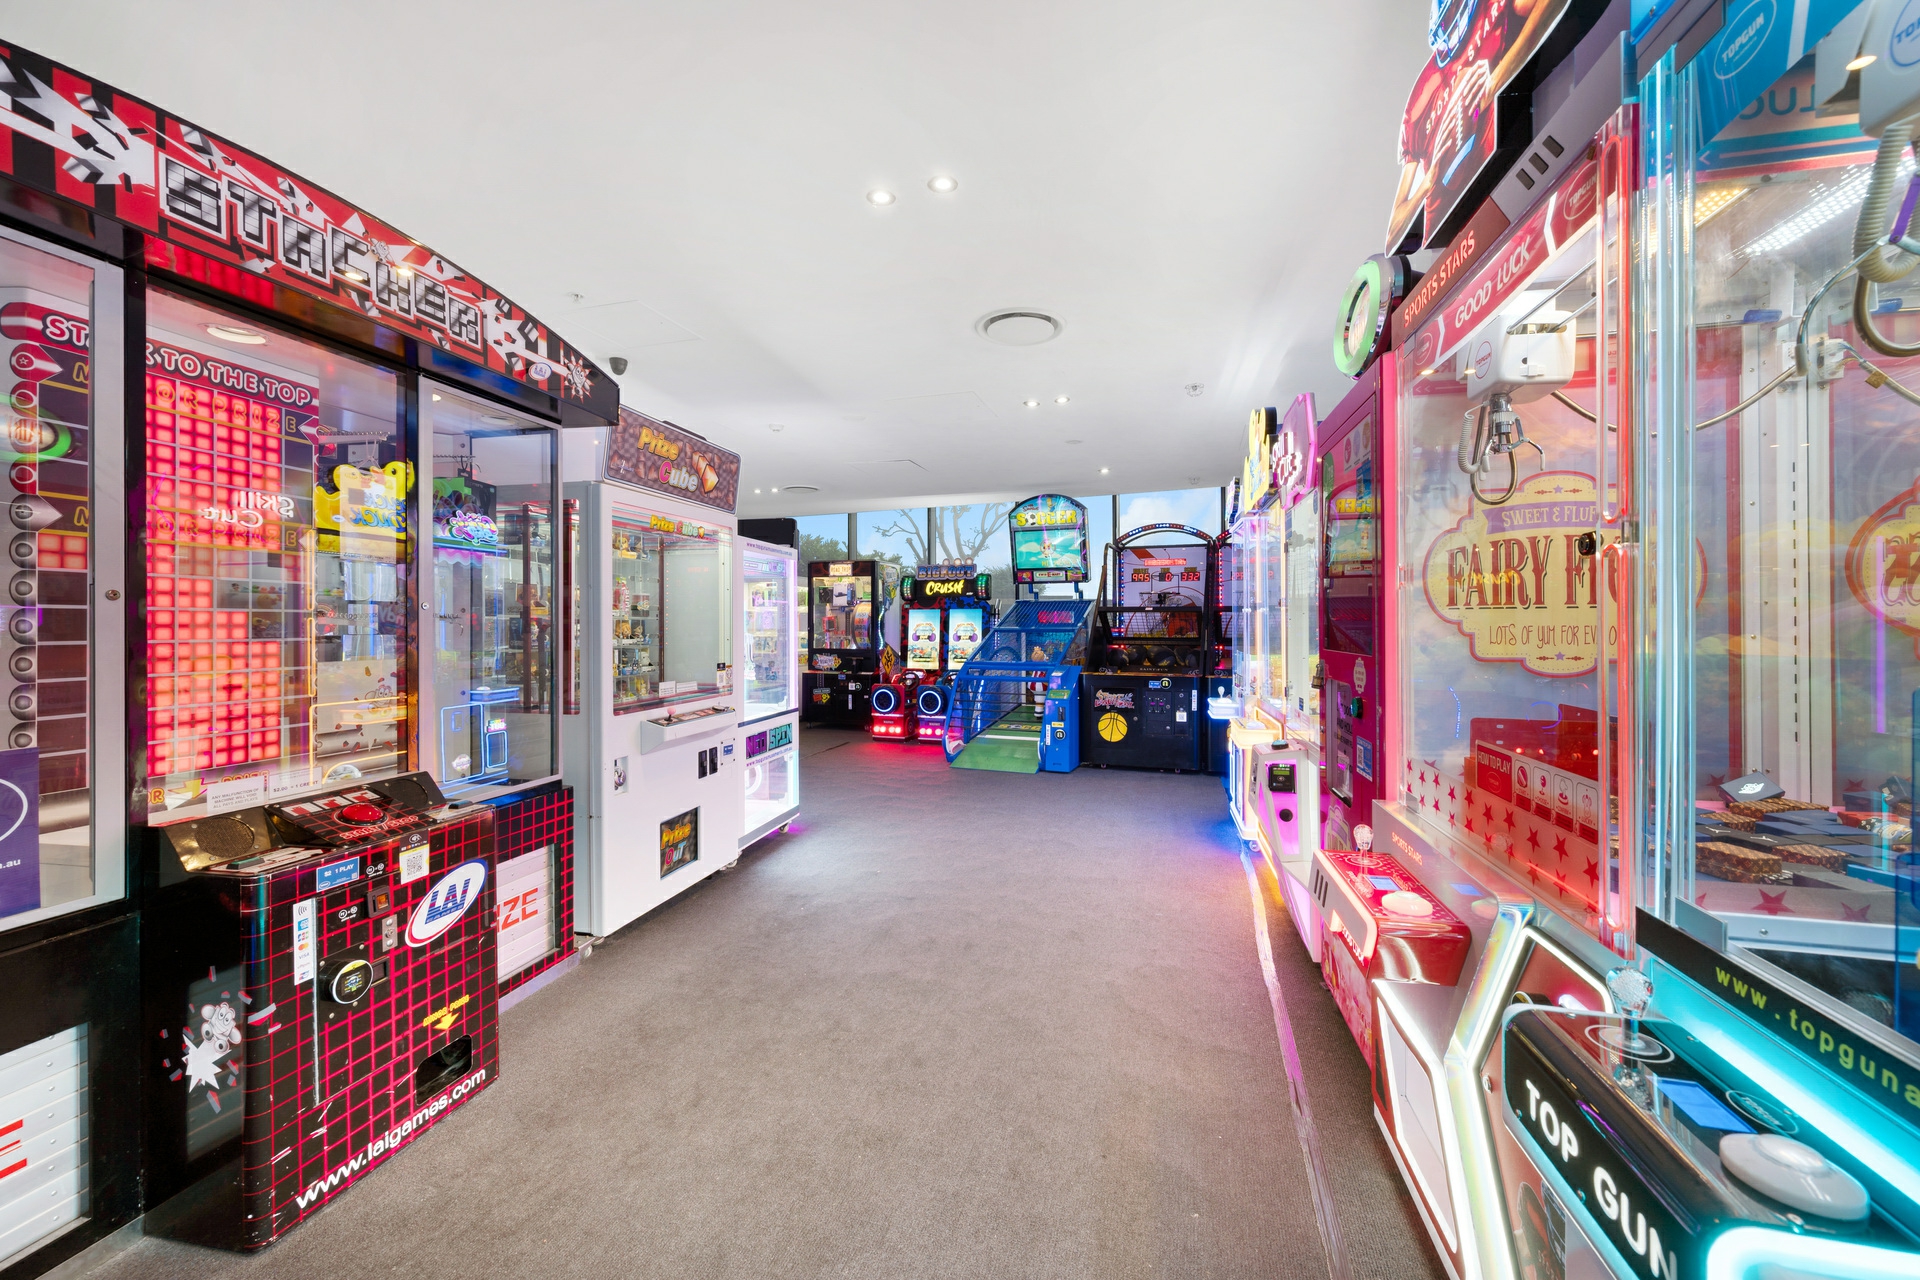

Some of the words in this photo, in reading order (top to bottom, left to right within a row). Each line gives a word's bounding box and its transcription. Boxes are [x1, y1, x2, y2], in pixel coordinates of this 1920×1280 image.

[1721, 13, 1765, 63] TOPGUN
[160, 153, 483, 350] STACKER
[1404, 278, 1438, 328] SPORTS
[1440, 230, 1476, 287] STARS
[1455, 280, 1493, 329] GOOD
[1496, 235, 1530, 291] LUCK
[159, 346, 202, 377] TO
[208, 361, 259, 393] THE
[264, 379, 312, 408] TOP
[637, 426, 680, 461] Prize
[659, 460, 698, 493] Cube
[650, 514, 676, 533] Prize
[675, 520, 699, 538] Cube
[1016, 510, 1077, 527] SOCCER
[1501, 507, 1549, 528] SWEET
[917, 565, 974, 578] BIGFOOT
[1132, 573, 1150, 582] 995
[1165, 573, 1171, 582] 0
[1182, 572, 1200, 581] 332
[1446, 534, 1554, 610] FAIRY
[925, 580, 965, 596] CRUSH
[1489, 624, 1517, 646] LOTS
[1521, 624, 1534, 645] OF
[1560, 625, 1580, 647] FOR
[746, 731, 768, 759] NEO
[768, 723, 792, 751] SPIN
[1478, 751, 1489, 766] HOW
[1489, 754, 1496, 769] TO
[1496, 757, 1511, 775] PLAY
[222, 788, 252, 799] MALFUNCTION
[660, 821, 692, 849] Prize
[1392, 832, 1409, 857] SPORTS
[1408, 846, 1423, 866] STARS
[340, 864, 354, 874] PLAY
[296, 1068, 486, 1209] www.laigames.com
[1525, 1079, 1579, 1162] TOP
[1593, 1166, 1677, 1280] GUN
